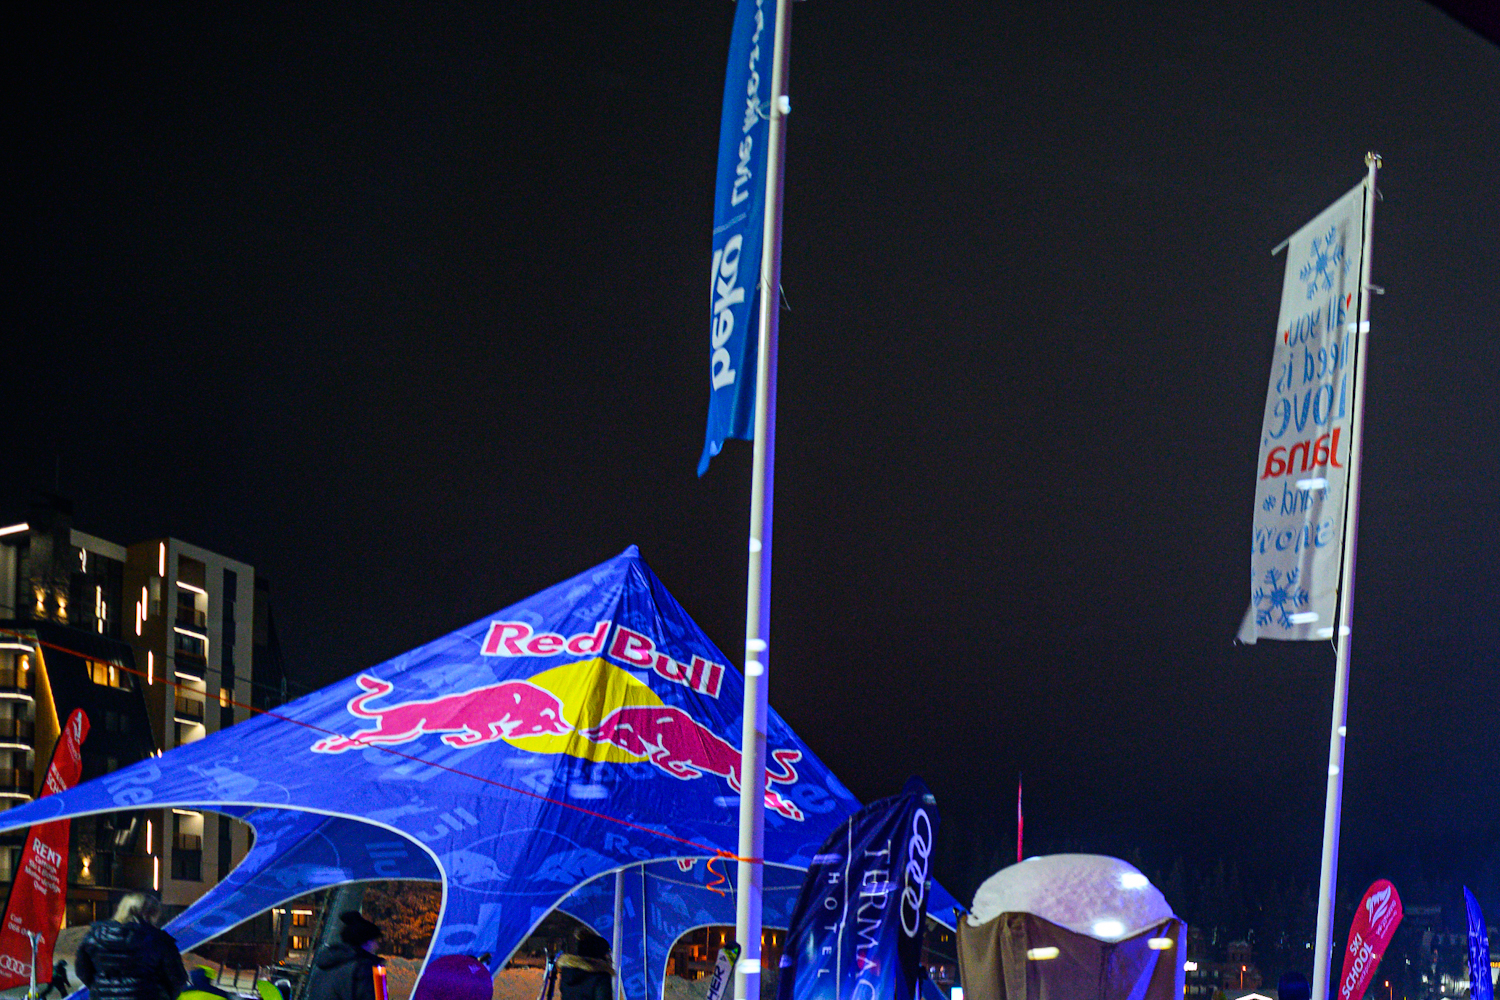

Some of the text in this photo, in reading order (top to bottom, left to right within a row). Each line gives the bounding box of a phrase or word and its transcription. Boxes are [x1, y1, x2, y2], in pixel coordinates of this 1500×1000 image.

[480, 620, 726, 700] Red Bull
[32, 836, 62, 869] RENT
[817, 872, 841, 978] HOTEL
[1349, 932, 1363, 957] SKI
